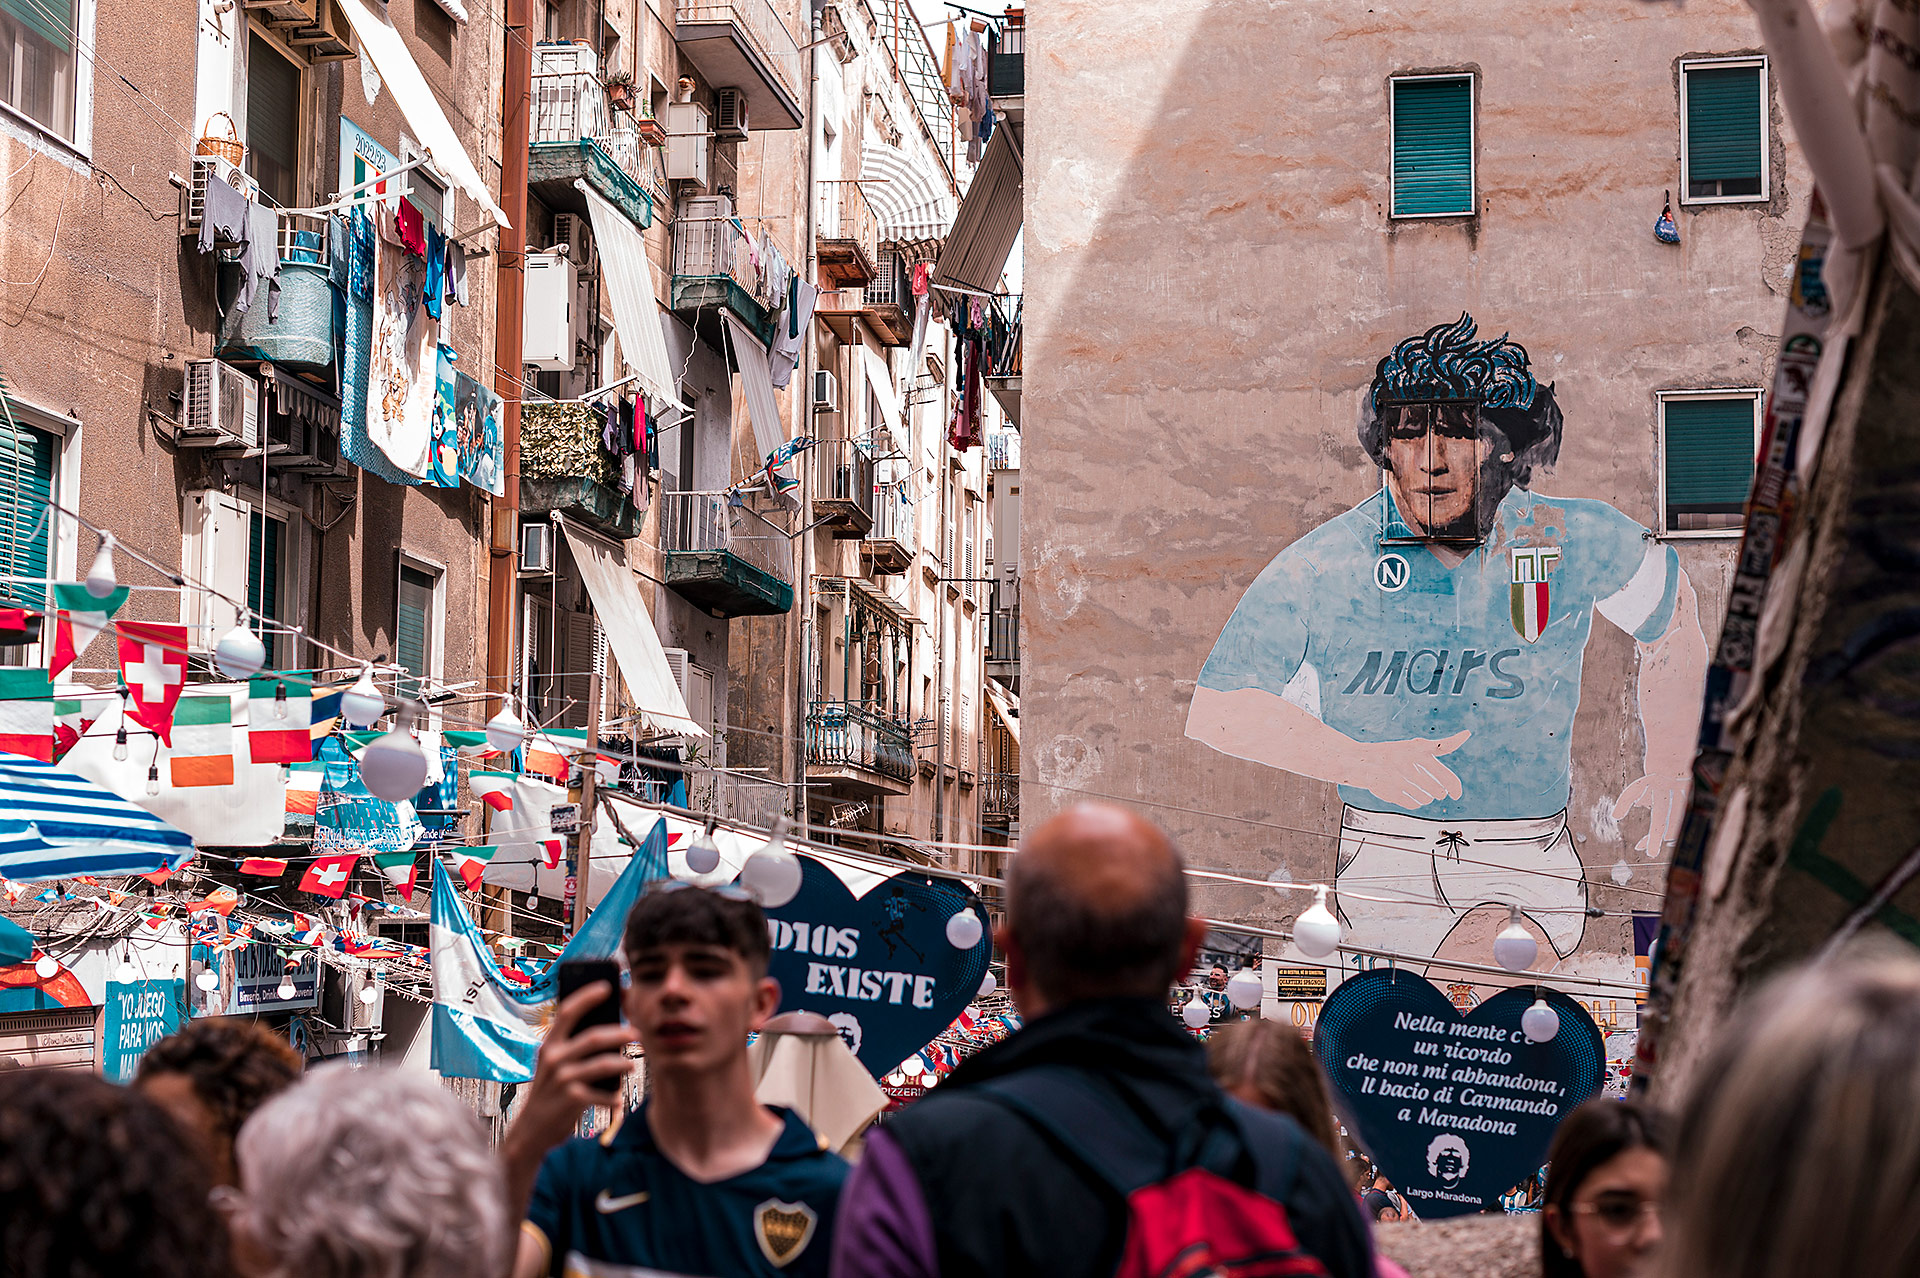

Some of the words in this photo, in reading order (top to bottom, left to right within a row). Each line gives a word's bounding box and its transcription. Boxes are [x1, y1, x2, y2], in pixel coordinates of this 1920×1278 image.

[355, 133, 387, 173] 2022/23
[1381, 561, 1402, 586] N
[805, 962, 936, 1009] EXISTE
[134, 991, 165, 1019] JUEGO
[119, 1022, 142, 1049] PARA
[145, 1020, 165, 1046] VOS
[1394, 1012, 1445, 1034] Nella
[1449, 1020, 1506, 1042] mente
[1346, 1053, 1379, 1072] che
[1382, 1059, 1419, 1077] non
[1422, 1062, 1448, 1080] mi
[1413, 1040, 1439, 1056] un
[1443, 1041, 1512, 1065] ricordo
[881, 1087, 928, 1097] PIZZERIA
[1379, 1081, 1430, 1100] bacio
[1433, 1086, 1454, 1104] di
[1459, 1088, 1558, 1117] Carmando
[1397, 1107, 1411, 1122] a
[1417, 1106, 1517, 1136] Maradona
[1406, 1186, 1433, 1199] Largo
[1435, 1190, 1482, 1204] Maradona
